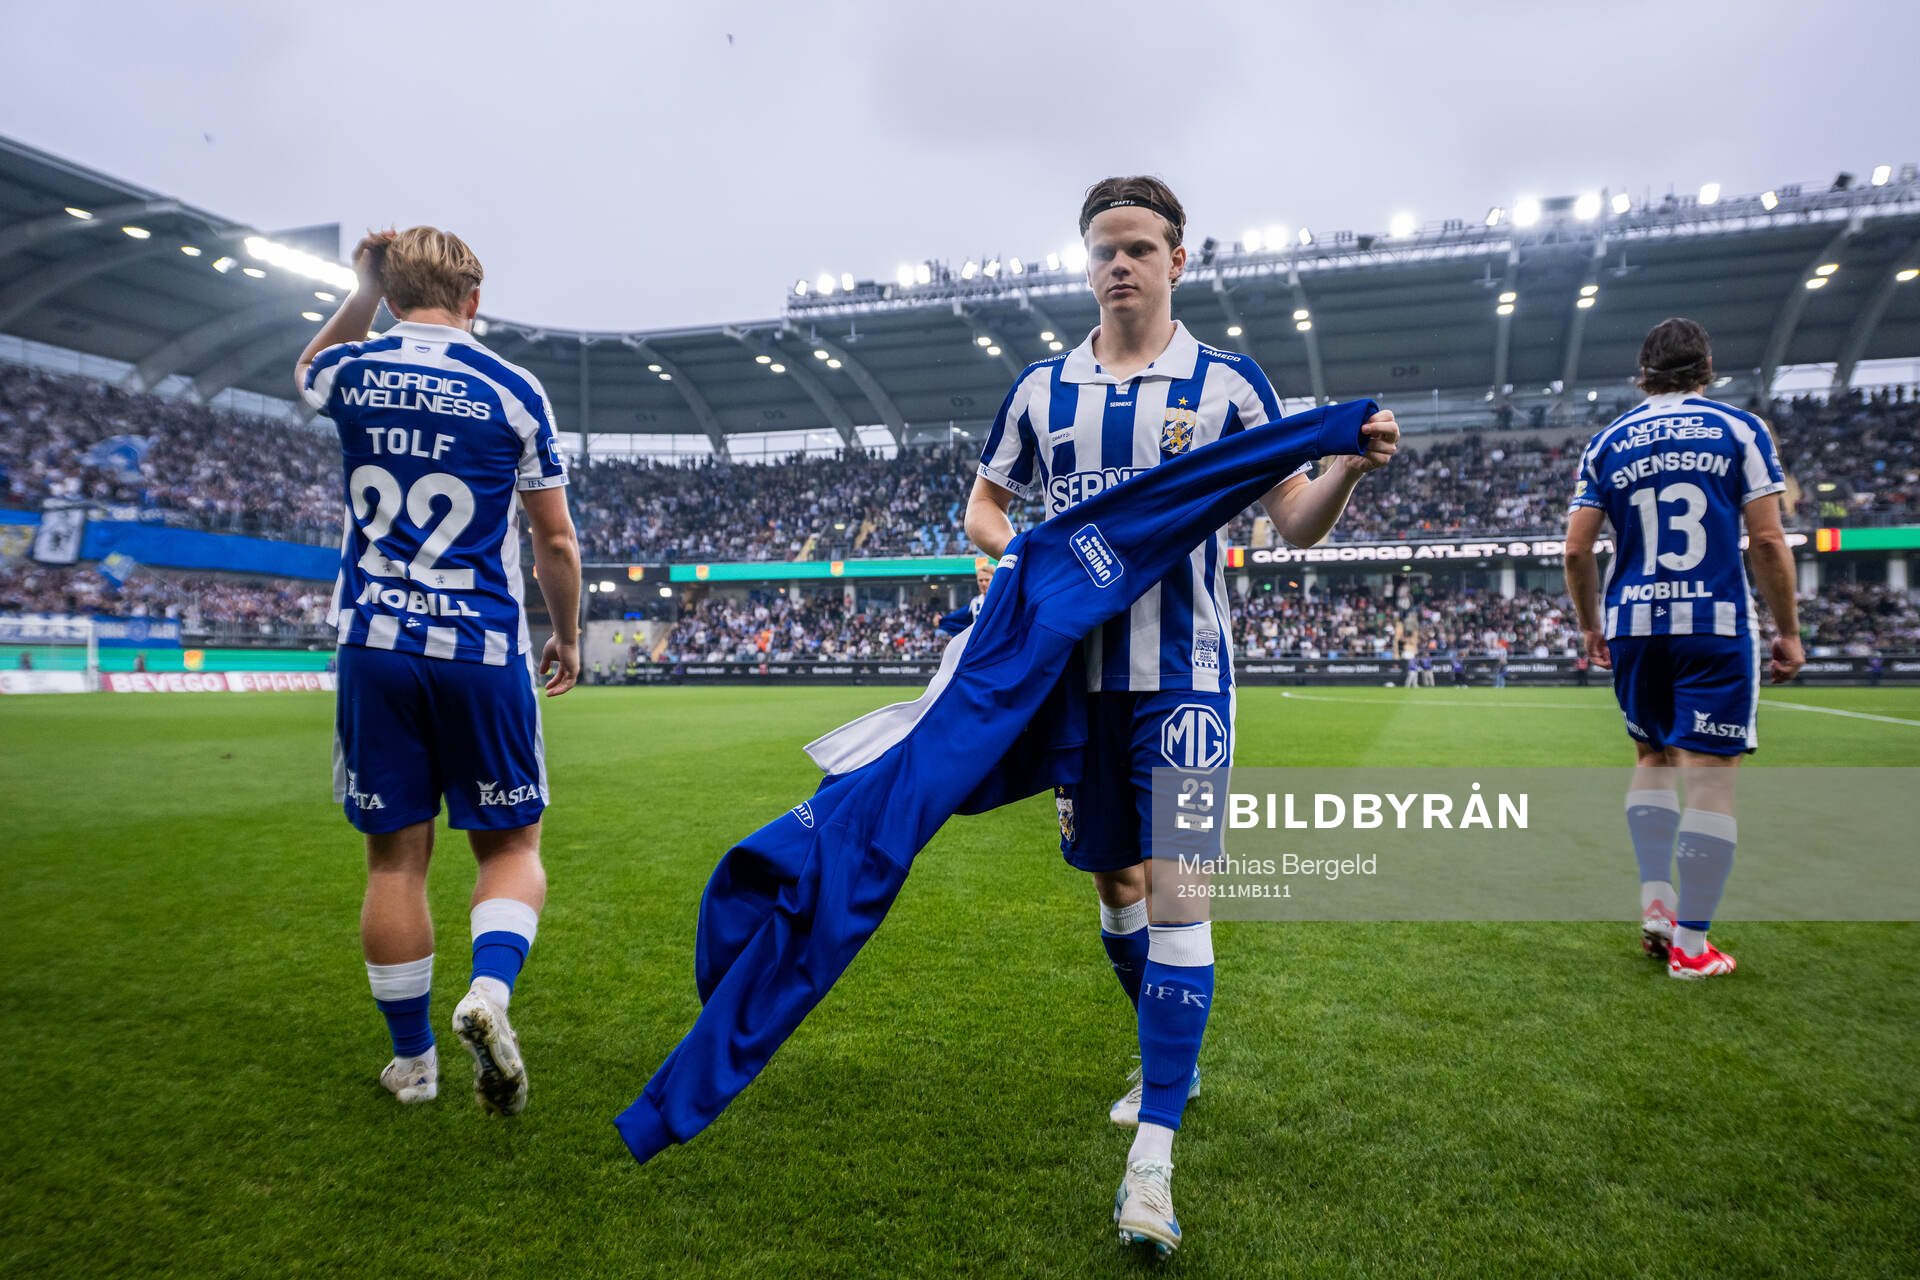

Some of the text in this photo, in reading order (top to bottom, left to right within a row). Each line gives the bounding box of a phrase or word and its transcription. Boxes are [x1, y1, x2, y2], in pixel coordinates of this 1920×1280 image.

[362, 368, 468, 398] NORDIC
[340, 386, 491, 421] WELLNESS
[1611, 427, 1724, 453] WELLNESS
[1627, 416, 1704, 437] NORDIC
[365, 427, 456, 460] TOLF
[1611, 451, 1732, 490] SVENSSON
[349, 464, 475, 590] 22
[1629, 482, 1708, 576] 13
[1075, 535, 1112, 582] UNIBET
[1251, 546, 1413, 563] GÖTEBORGS
[355, 582, 481, 617] MOBILL
[1620, 580, 1713, 605] MOBILL
[1166, 710, 1223, 768] MG
[1693, 719, 1749, 739] RASTA
[478, 783, 541, 807] RASTA
[1182, 777, 1214, 812] 23
[1144, 983, 1209, 1009] IFK
